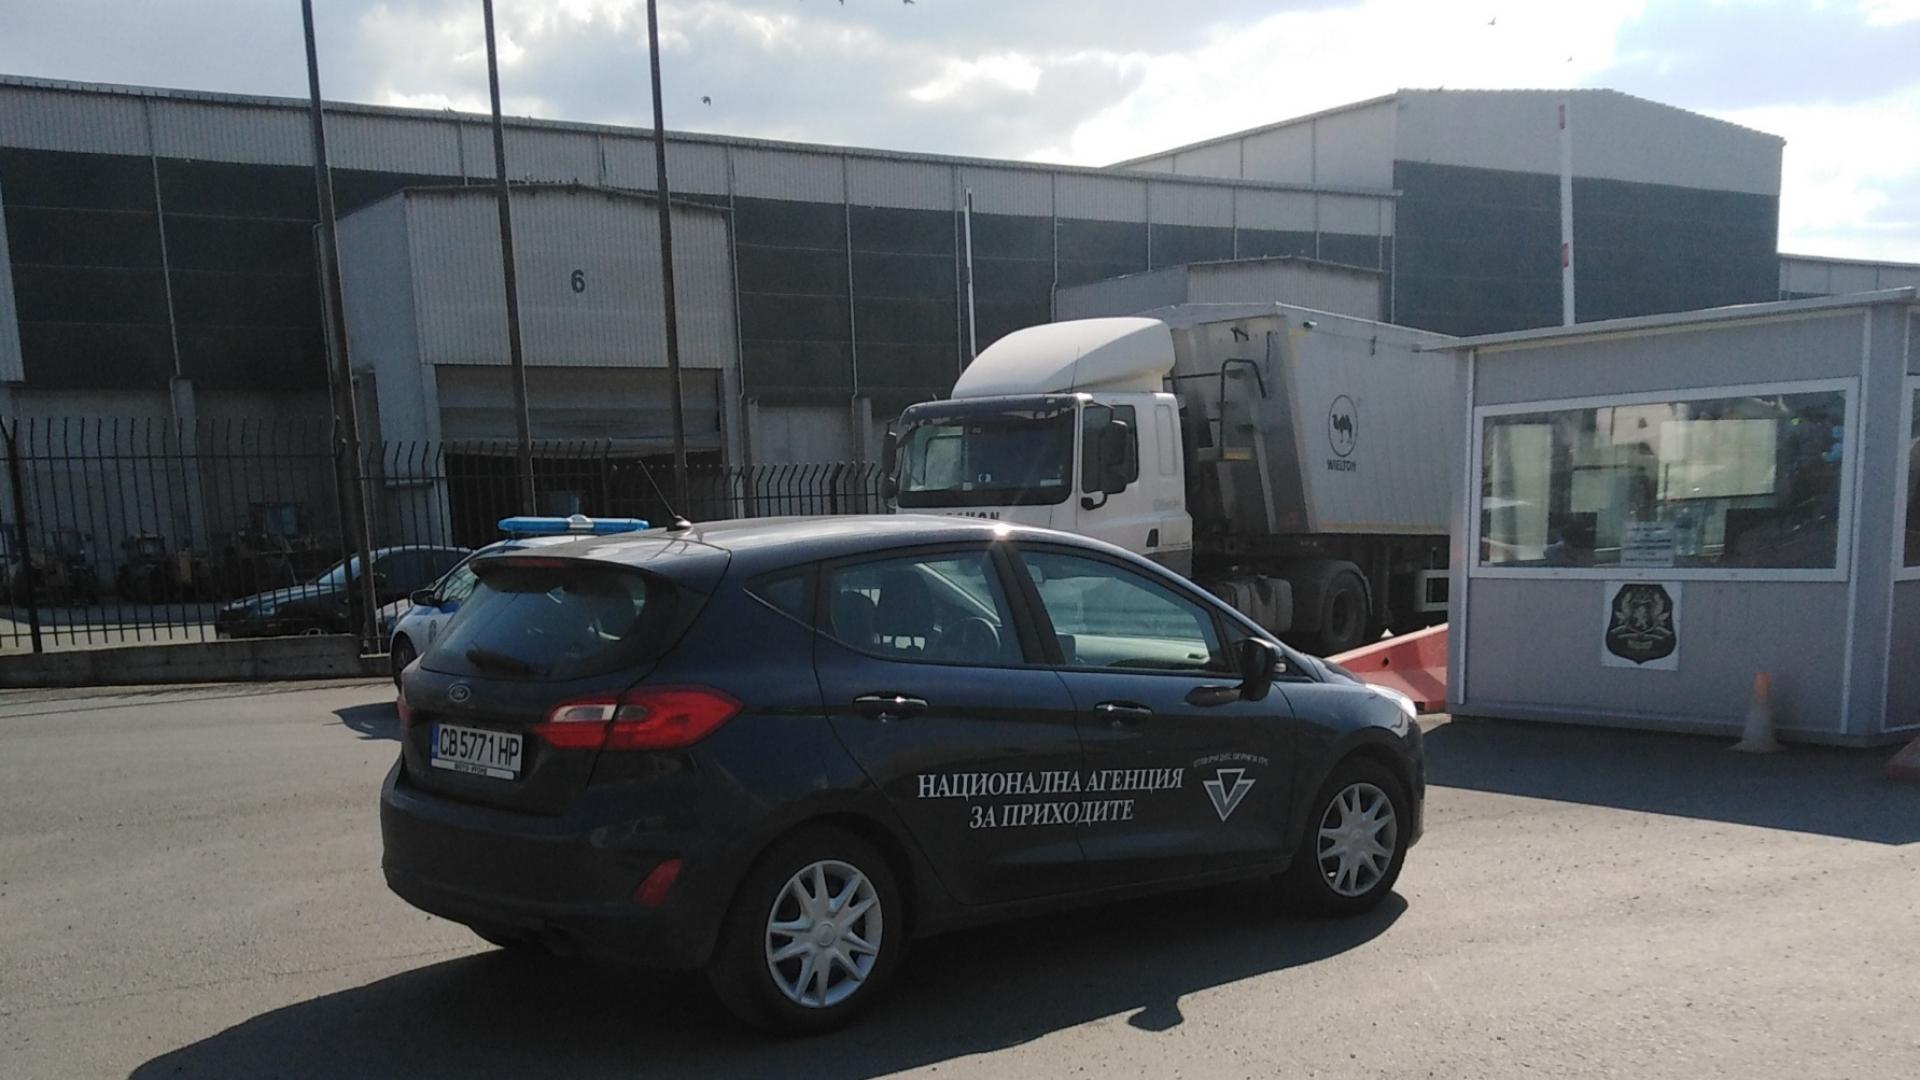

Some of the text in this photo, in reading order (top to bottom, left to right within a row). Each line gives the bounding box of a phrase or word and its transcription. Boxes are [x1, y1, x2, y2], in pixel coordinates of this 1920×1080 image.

[571, 269, 586, 293] 6
[440, 728, 520, 766] CB 5771 HP
[918, 768, 1185, 801] НАЦИОНАЛНА АГЕНЦИЯ
[969, 799, 1135, 829] ЗА ПРИХОДИТЕ
